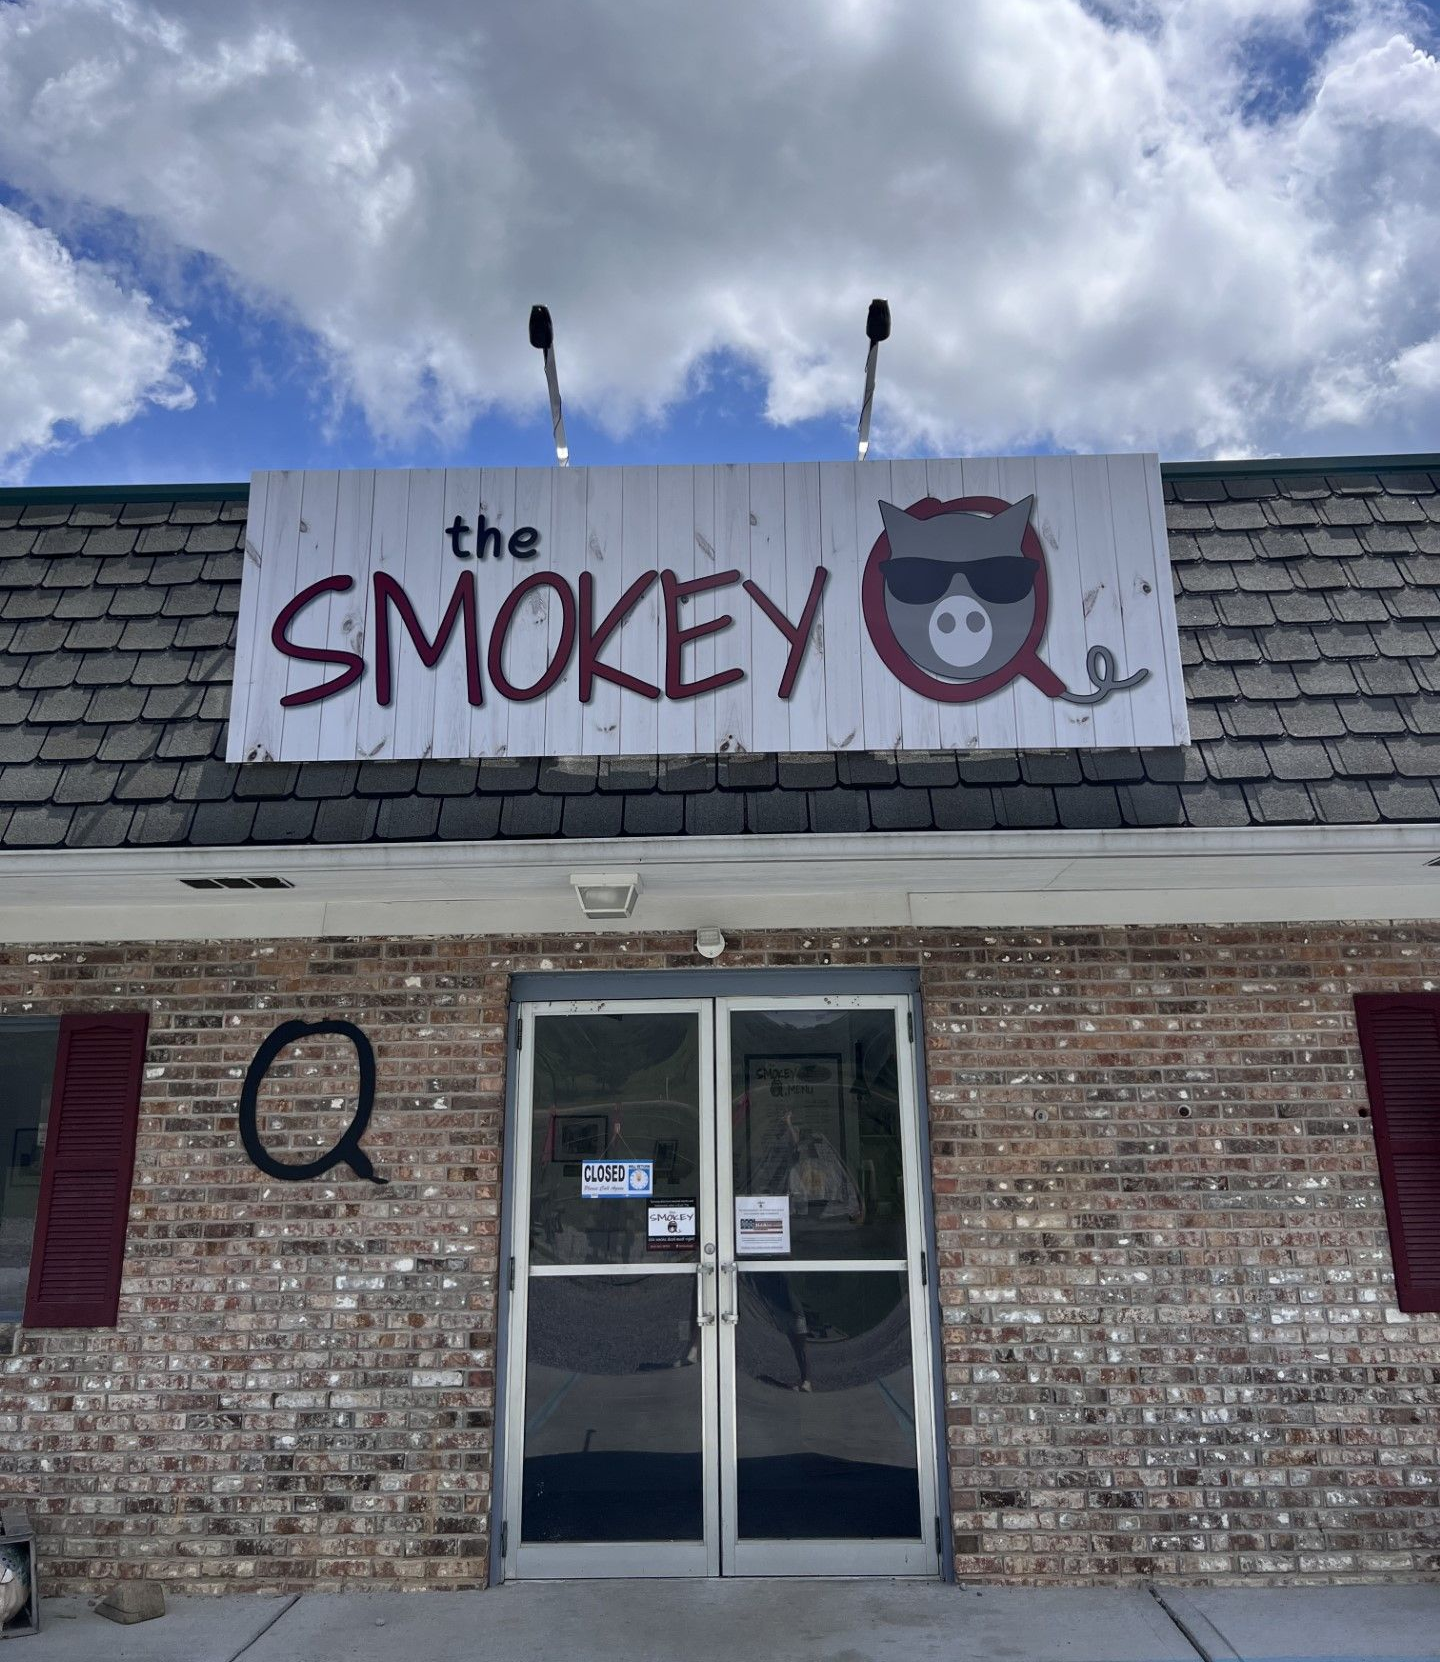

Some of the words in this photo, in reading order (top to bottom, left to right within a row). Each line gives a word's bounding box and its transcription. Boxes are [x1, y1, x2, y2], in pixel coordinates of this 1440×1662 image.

[445, 513, 539, 559] the
[270, 565, 827, 706] SMOKEY
[239, 1019, 389, 1184] Q
[787, 1085, 815, 1096] MENU
[584, 1164, 626, 1183] CLOSED
[649, 1213, 694, 1222] SMOKEY
